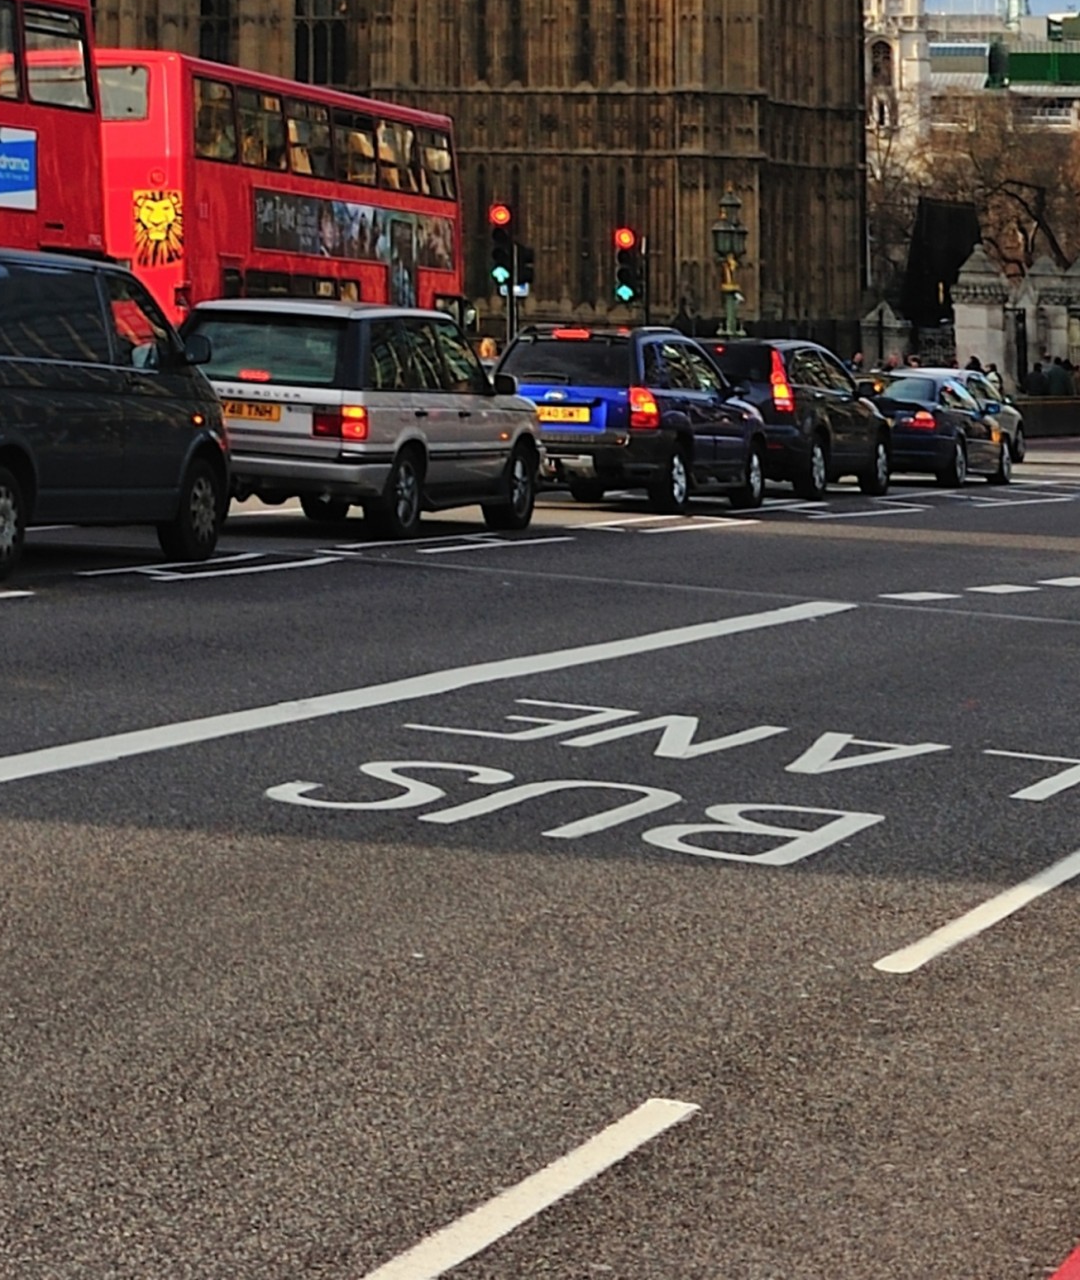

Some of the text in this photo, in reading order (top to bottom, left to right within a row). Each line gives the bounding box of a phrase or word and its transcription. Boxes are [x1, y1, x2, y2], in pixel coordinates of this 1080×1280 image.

[253, 389, 302, 399] ROVER
[403, 698, 1080, 802] LANE
[265, 760, 886, 866] BUS
